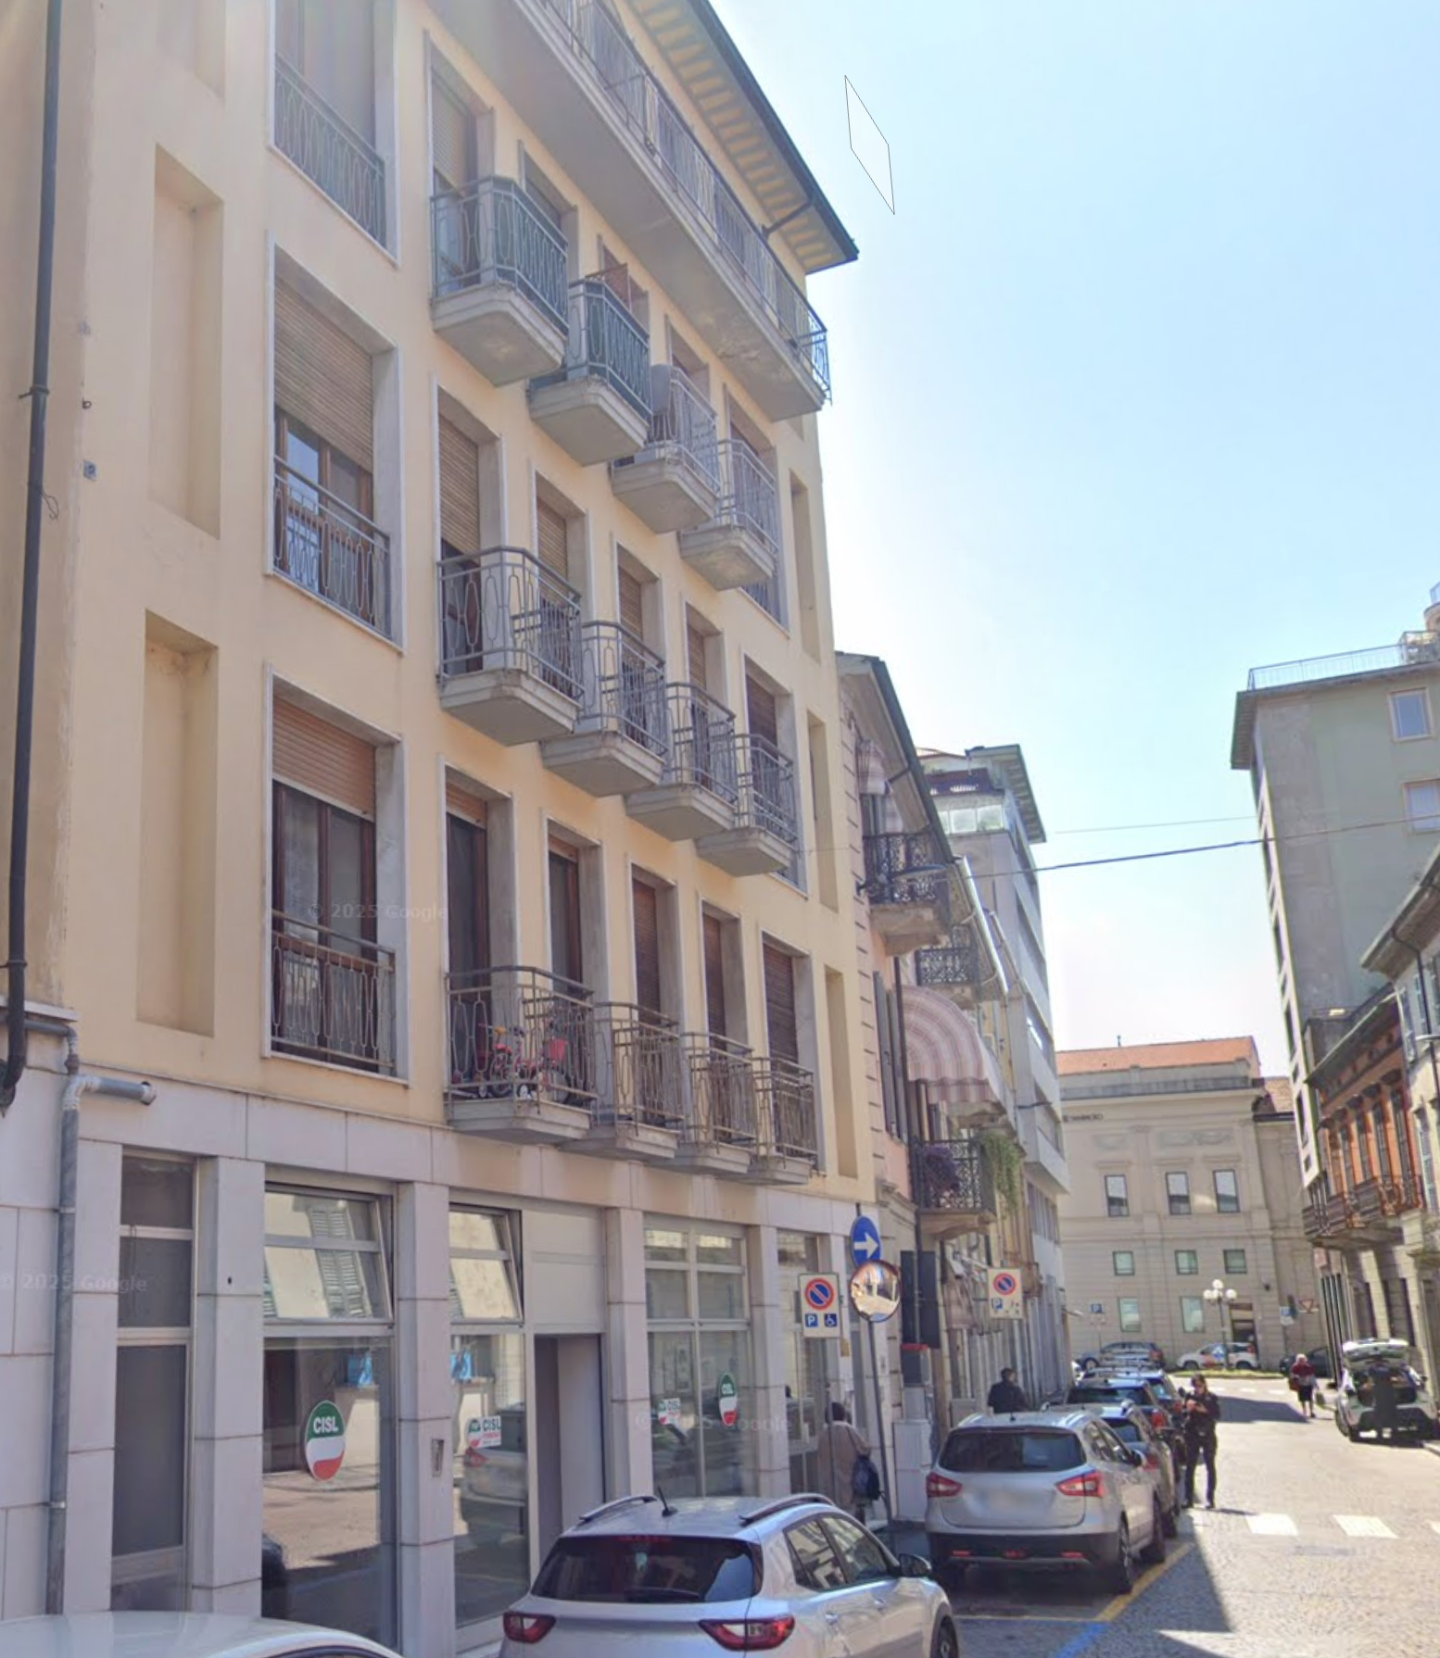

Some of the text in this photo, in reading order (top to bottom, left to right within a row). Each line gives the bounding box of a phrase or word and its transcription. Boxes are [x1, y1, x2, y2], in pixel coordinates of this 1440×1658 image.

[807, 1314, 816, 1326] P
[313, 1415, 339, 1434] CISL
[482, 1417, 501, 1432] CISL
